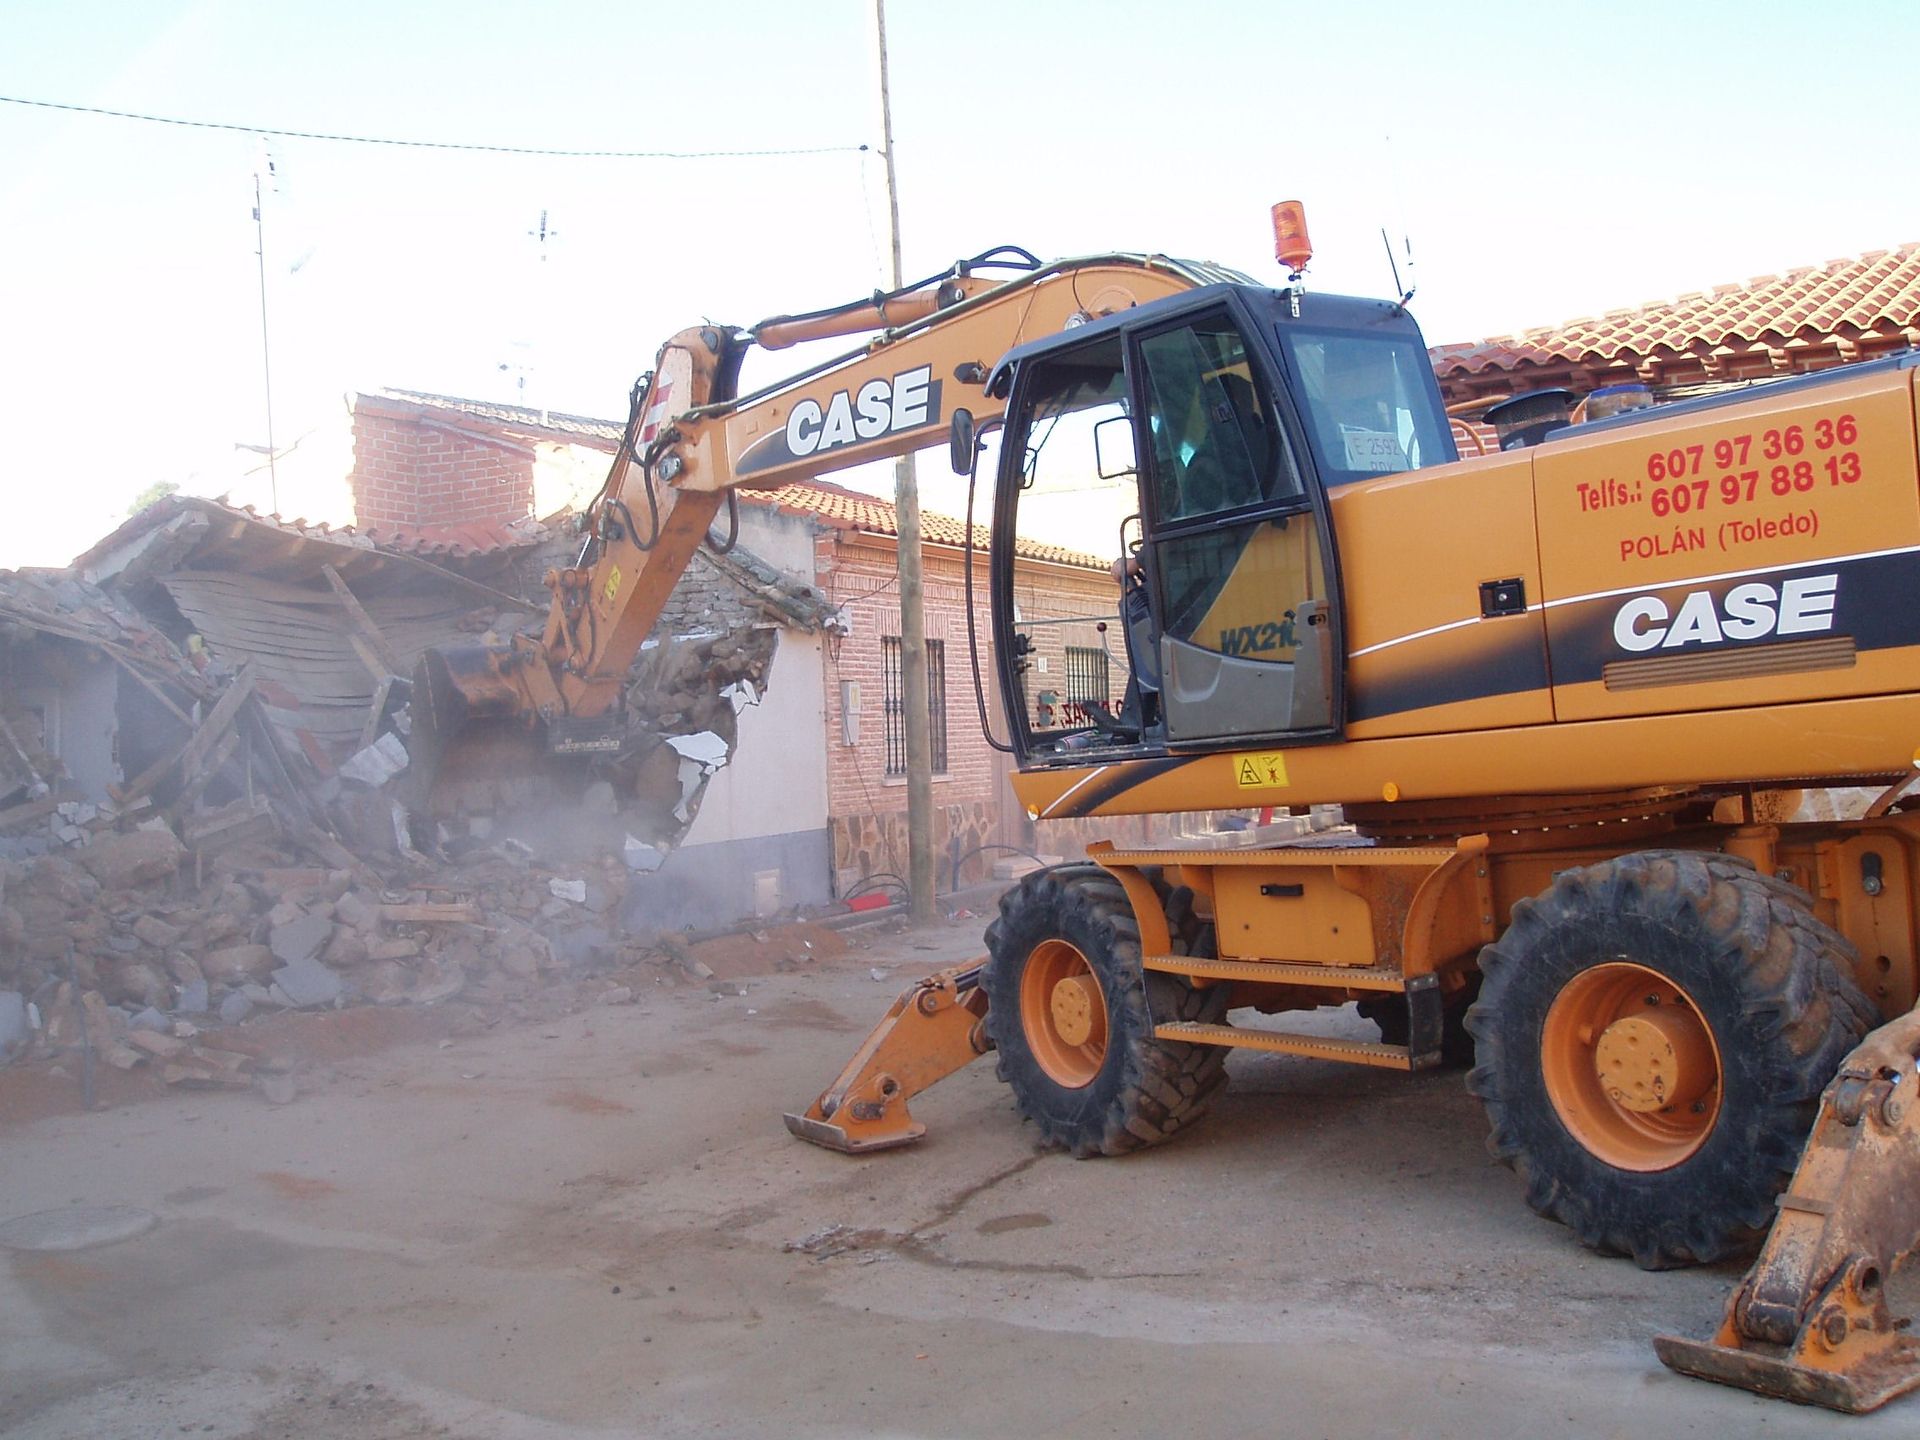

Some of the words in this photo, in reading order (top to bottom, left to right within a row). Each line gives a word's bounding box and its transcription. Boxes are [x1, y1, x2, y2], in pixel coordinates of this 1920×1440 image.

[786, 364, 931, 456] CASE
[1647, 445, 1704, 482] 607
[1714, 435, 1752, 469] 97
[1762, 425, 1804, 460] 36
[1814, 415, 1857, 450] 36
[1651, 480, 1709, 517] 607
[1719, 471, 1759, 505] 97
[1770, 461, 1814, 496] 88
[1824, 452, 1861, 486] 13
[1620, 526, 1705, 561] POLÁN
[1718, 509, 1819, 550] (Toledo)
[1613, 574, 1838, 651] CASE
